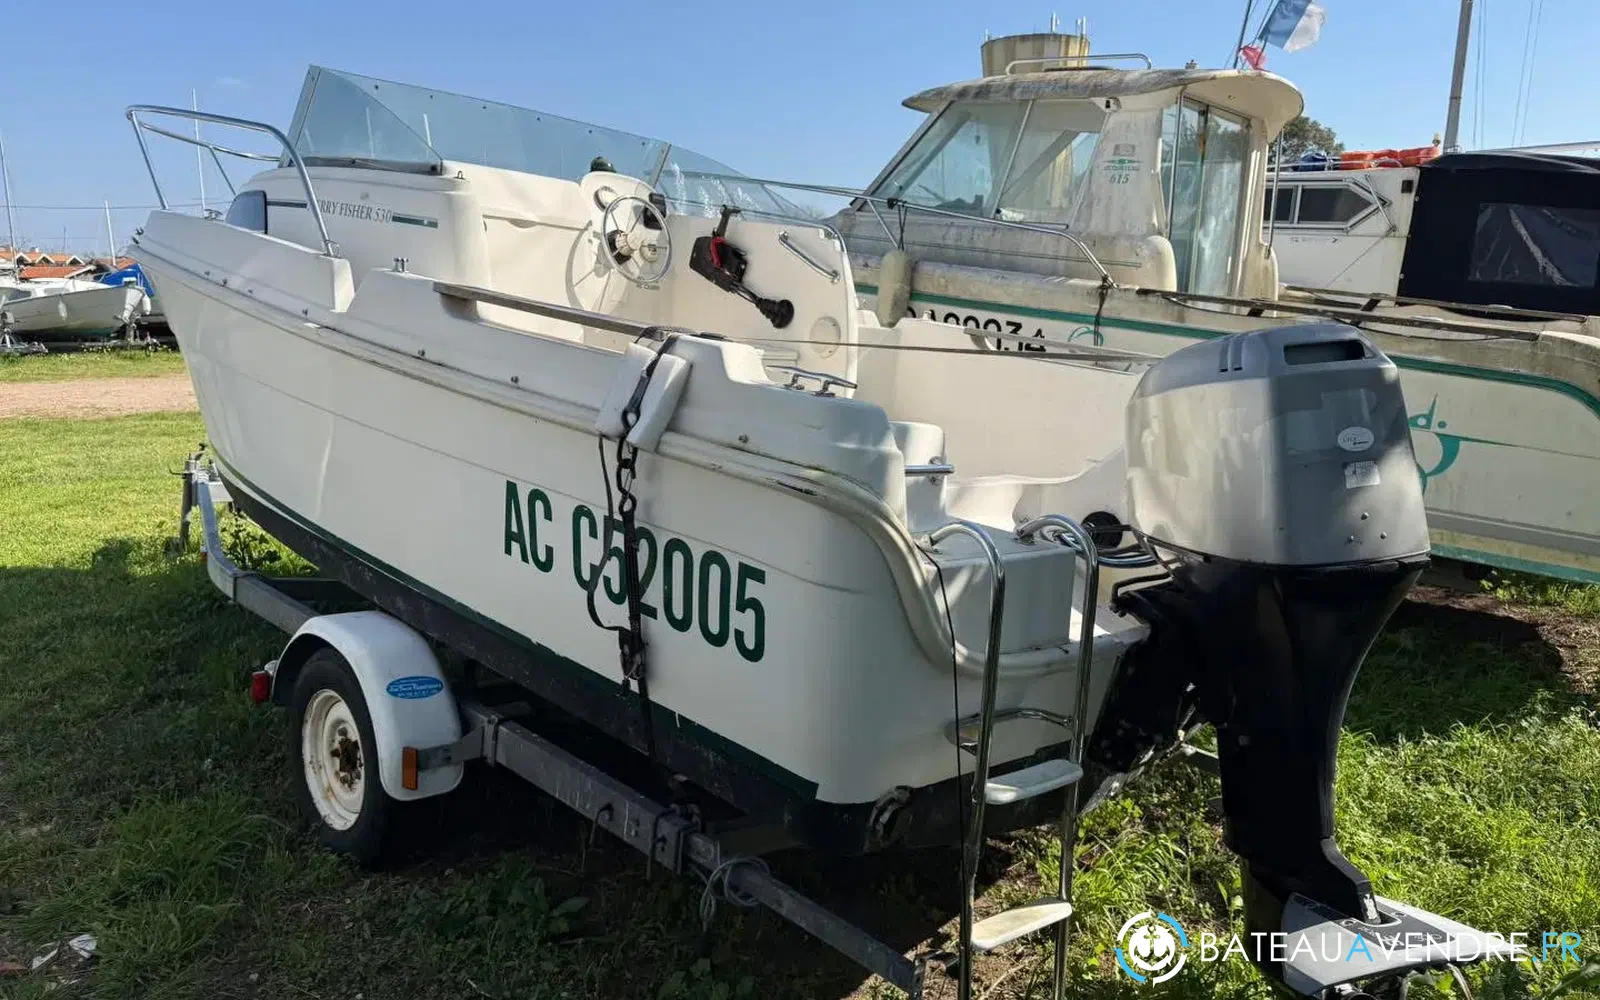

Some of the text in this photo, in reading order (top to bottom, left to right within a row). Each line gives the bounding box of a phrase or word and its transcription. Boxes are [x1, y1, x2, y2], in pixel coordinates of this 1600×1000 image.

[340, 202, 373, 220] FISHER
[374, 208, 392, 223] 530
[504, 479, 766, 663] AC C52005
